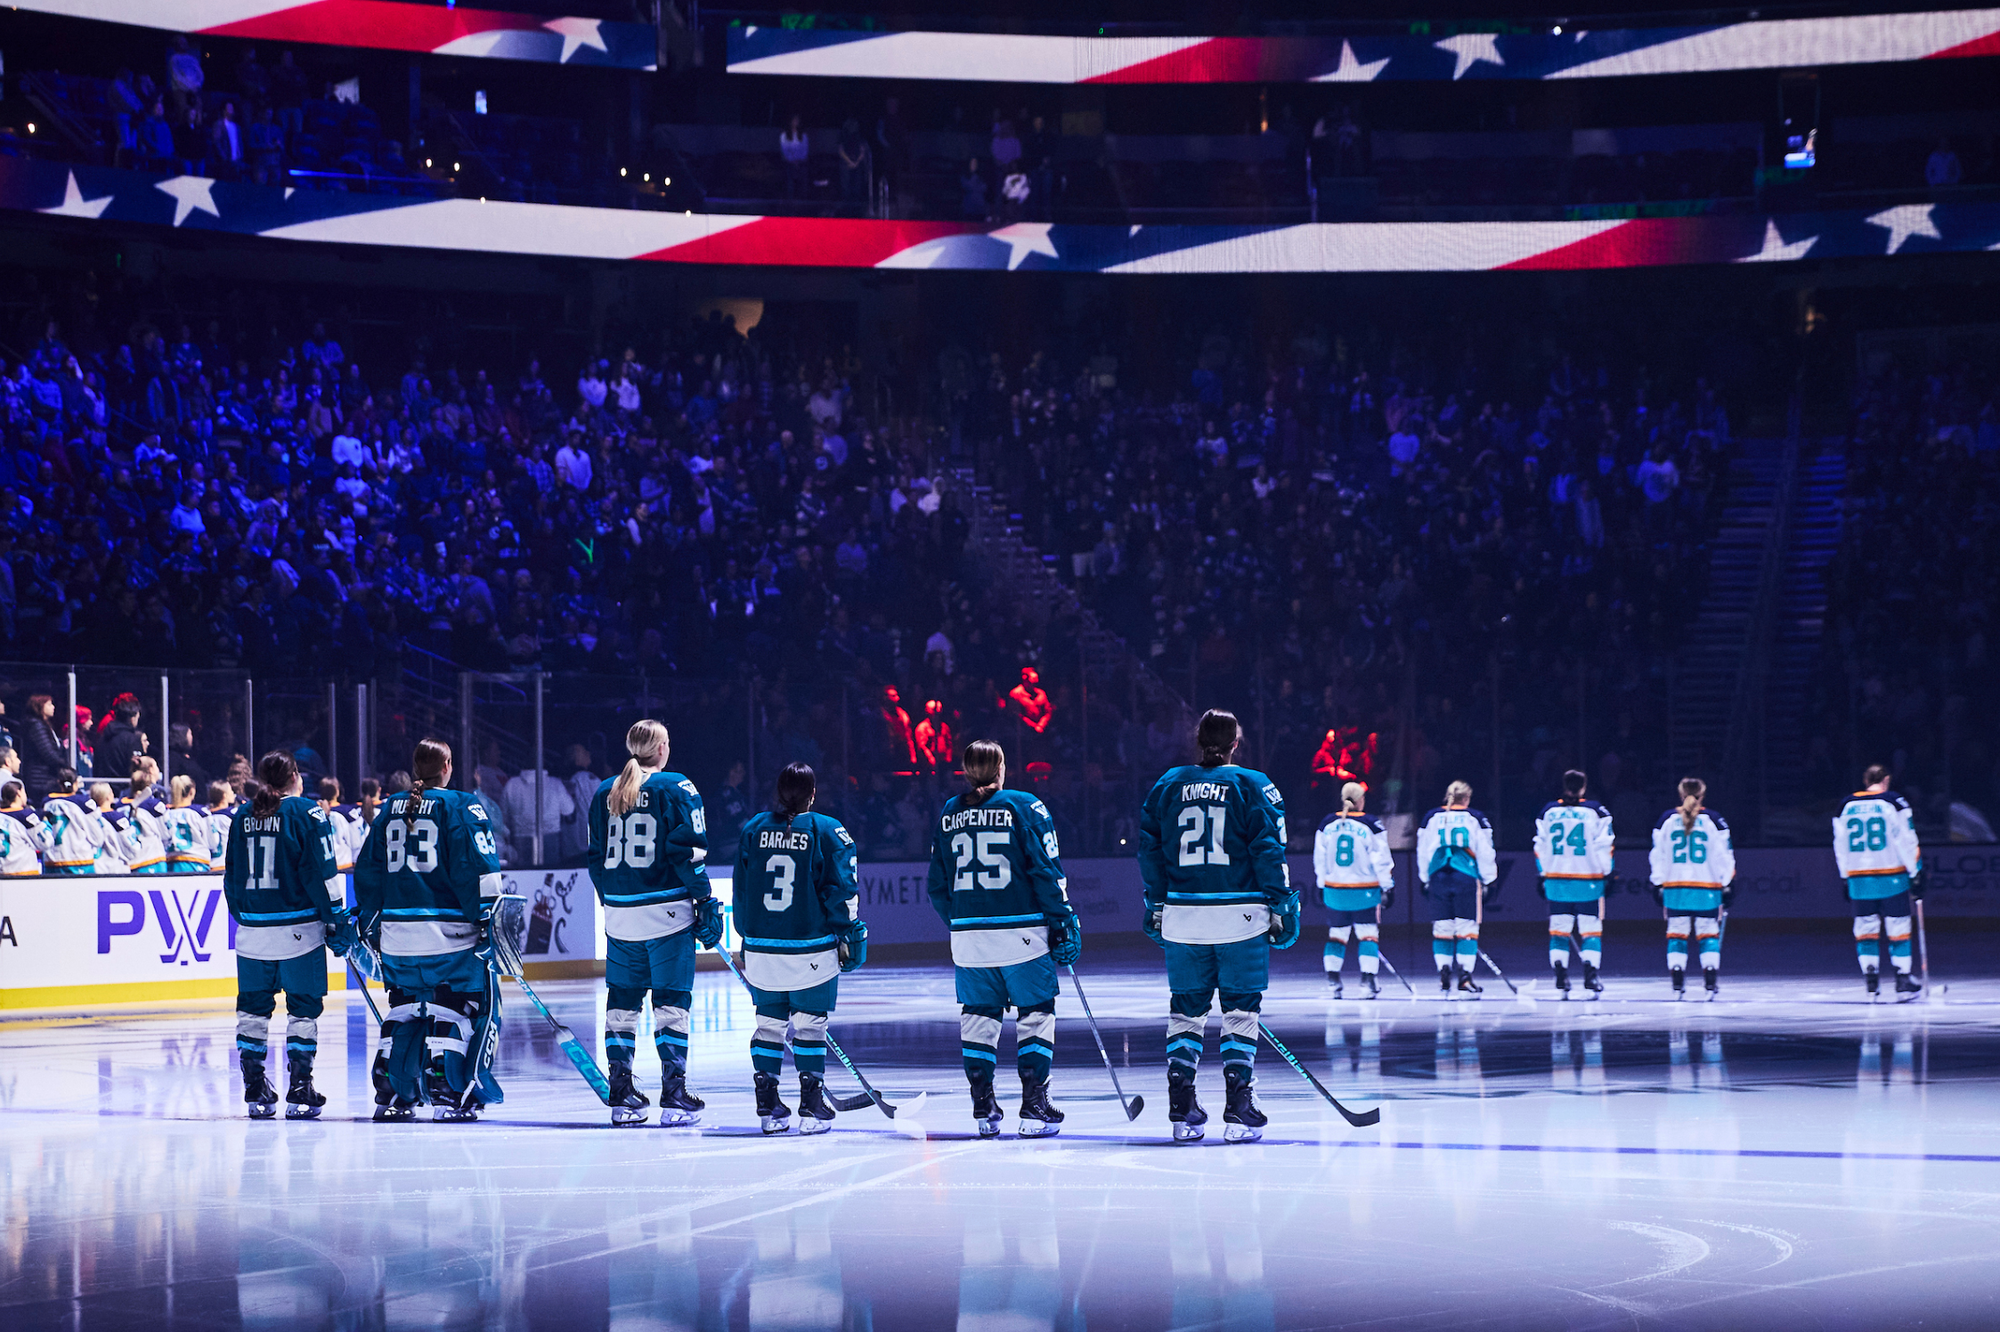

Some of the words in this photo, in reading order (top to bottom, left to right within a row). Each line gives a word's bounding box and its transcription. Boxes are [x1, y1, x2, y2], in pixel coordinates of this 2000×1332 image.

[391, 799, 435, 815] MUHY
[1182, 783, 1229, 802] KNIGHT
[243, 816, 280, 833] BROWN
[942, 809, 1013, 832] CARPENTER
[1178, 805, 1230, 867] 21
[1438, 827, 1469, 848] 10
[1847, 817, 1886, 852] 28
[385, 819, 438, 873] 83
[604, 813, 657, 869] 88
[759, 831, 808, 850] BARNES
[1336, 834, 1354, 866] 8
[1550, 823, 1587, 856] 24
[1671, 830, 1708, 864] 26
[245, 836, 279, 889] 11
[951, 832, 1012, 892] 25
[763, 854, 796, 911] 3
[482, 1020, 498, 1069] CCM
